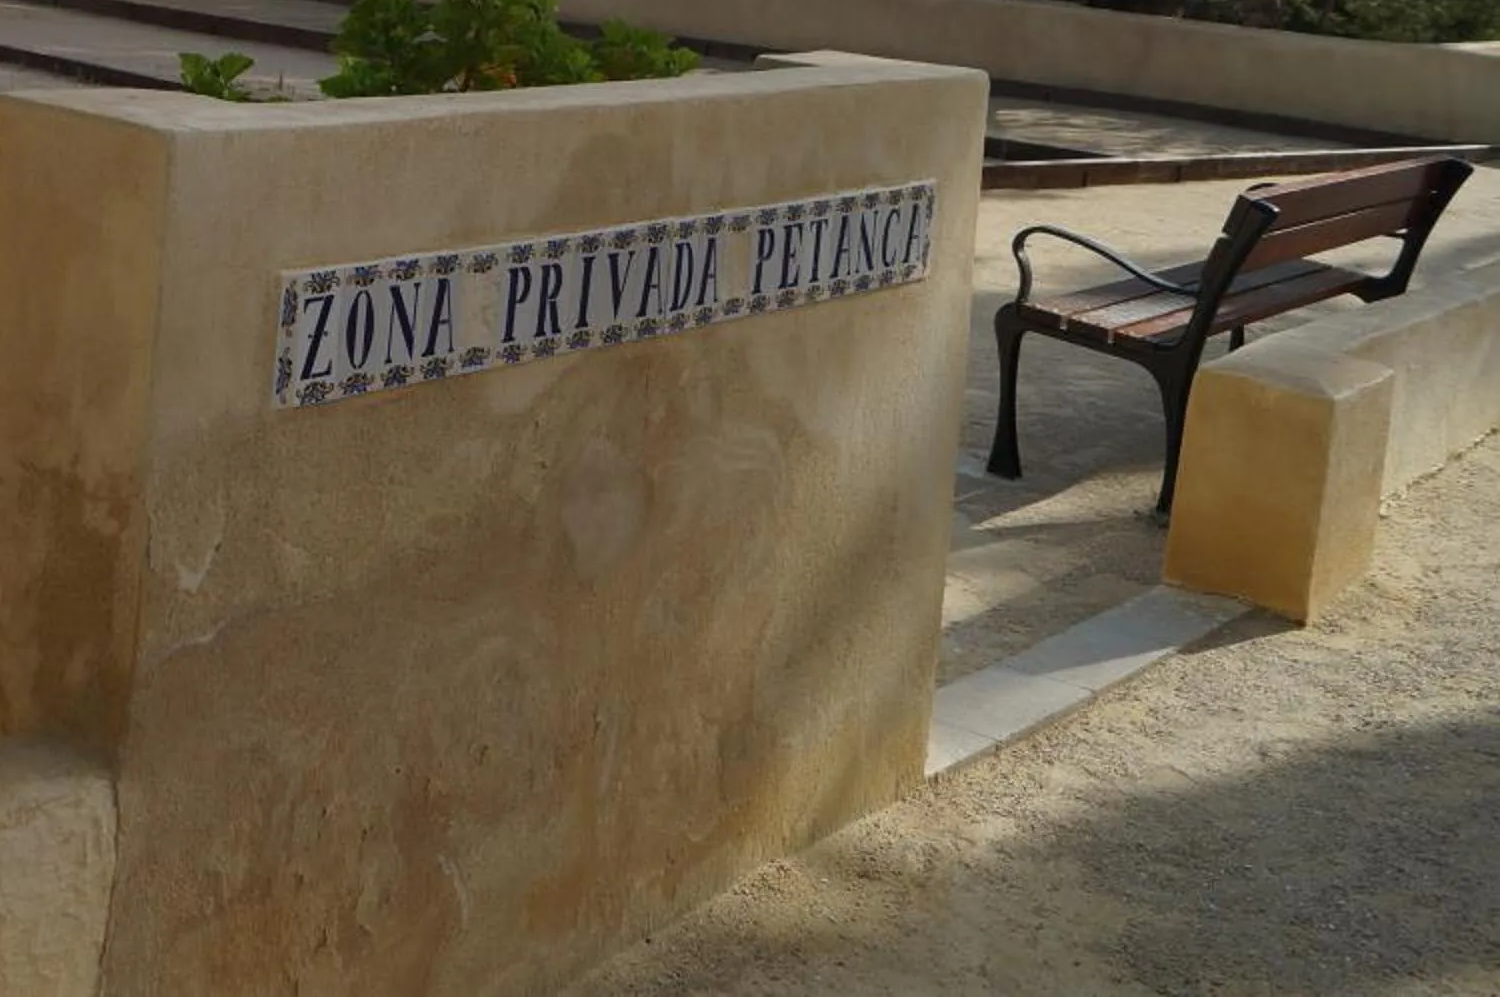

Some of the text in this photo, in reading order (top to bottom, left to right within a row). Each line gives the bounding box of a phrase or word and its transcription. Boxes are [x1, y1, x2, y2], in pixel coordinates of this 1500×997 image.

[301, 202, 922, 380] ZONA PRIVADA PETANCA
